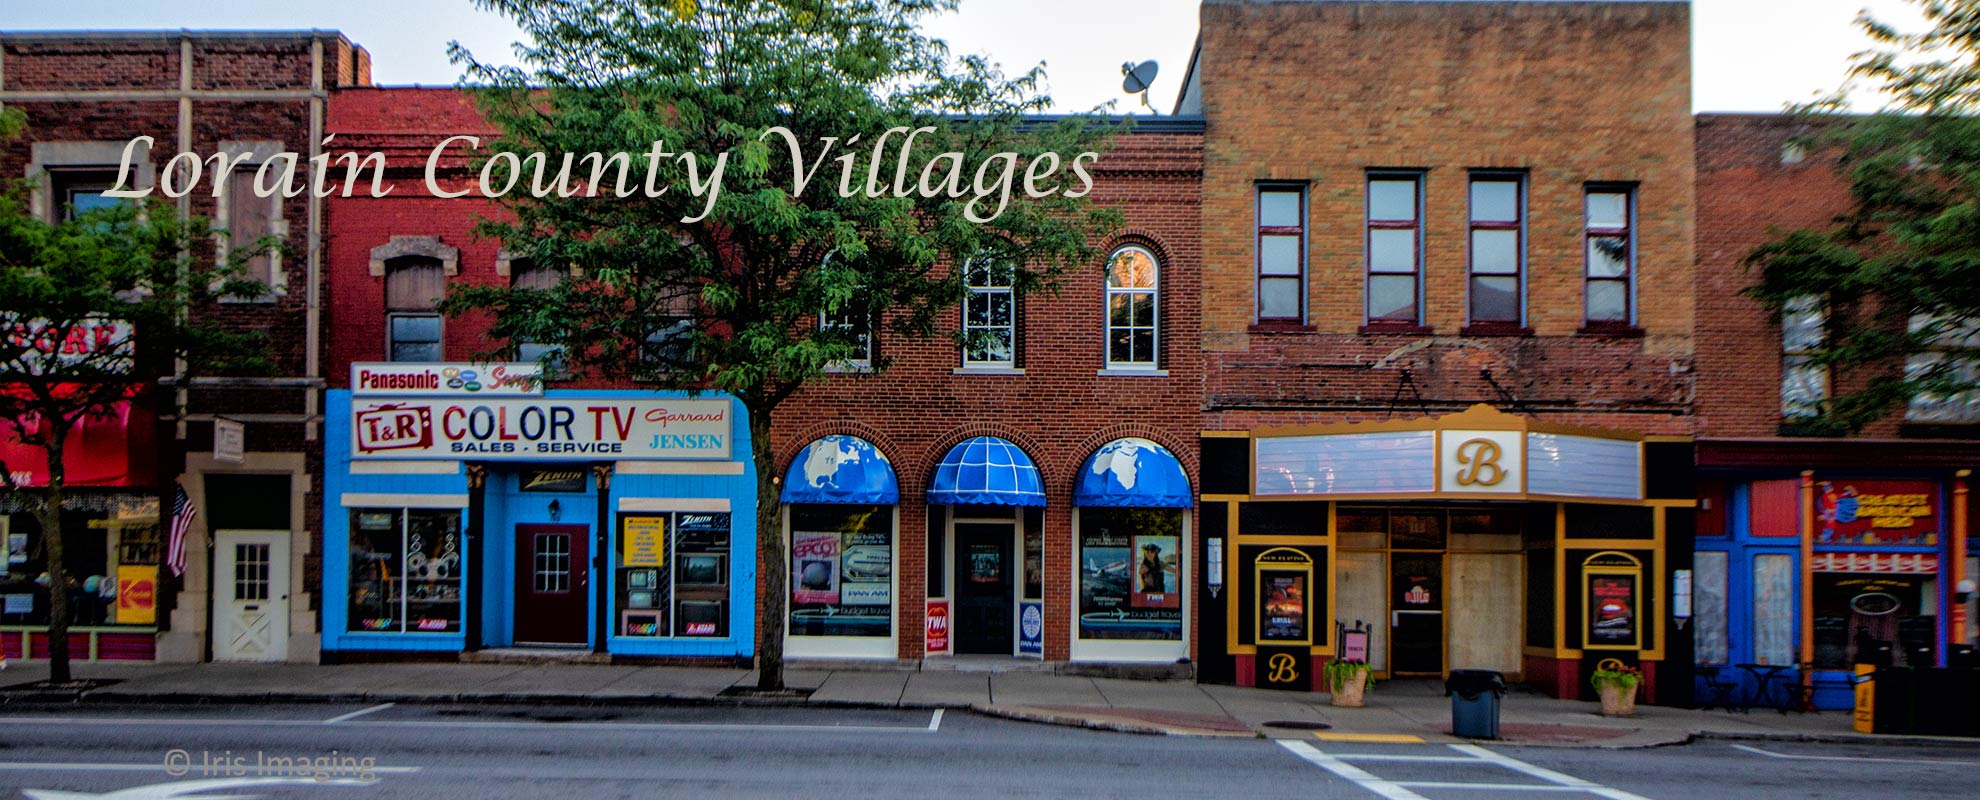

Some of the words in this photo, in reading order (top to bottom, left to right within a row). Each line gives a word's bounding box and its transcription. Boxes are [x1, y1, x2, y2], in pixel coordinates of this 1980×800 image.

[360, 370, 439, 390] Panasonic
[442, 405, 575, 441] COLOR
[587, 406, 636, 441] TV
[644, 408, 724, 428] Garrard
[363, 413, 418, 443] T&R
[451, 442, 515, 453] SALES
[537, 442, 623, 453] SERVICE
[649, 434, 723, 449] JENSEN
[1456, 437, 1508, 486] B
[680, 515, 713, 526] ZENITH
[794, 539, 840, 558] EPCOT
[1147, 593, 1164, 601] TWA
[928, 615, 947, 630] TWA
[1020, 640, 1032, 648] PAN
[1268, 653, 1299, 683] B
